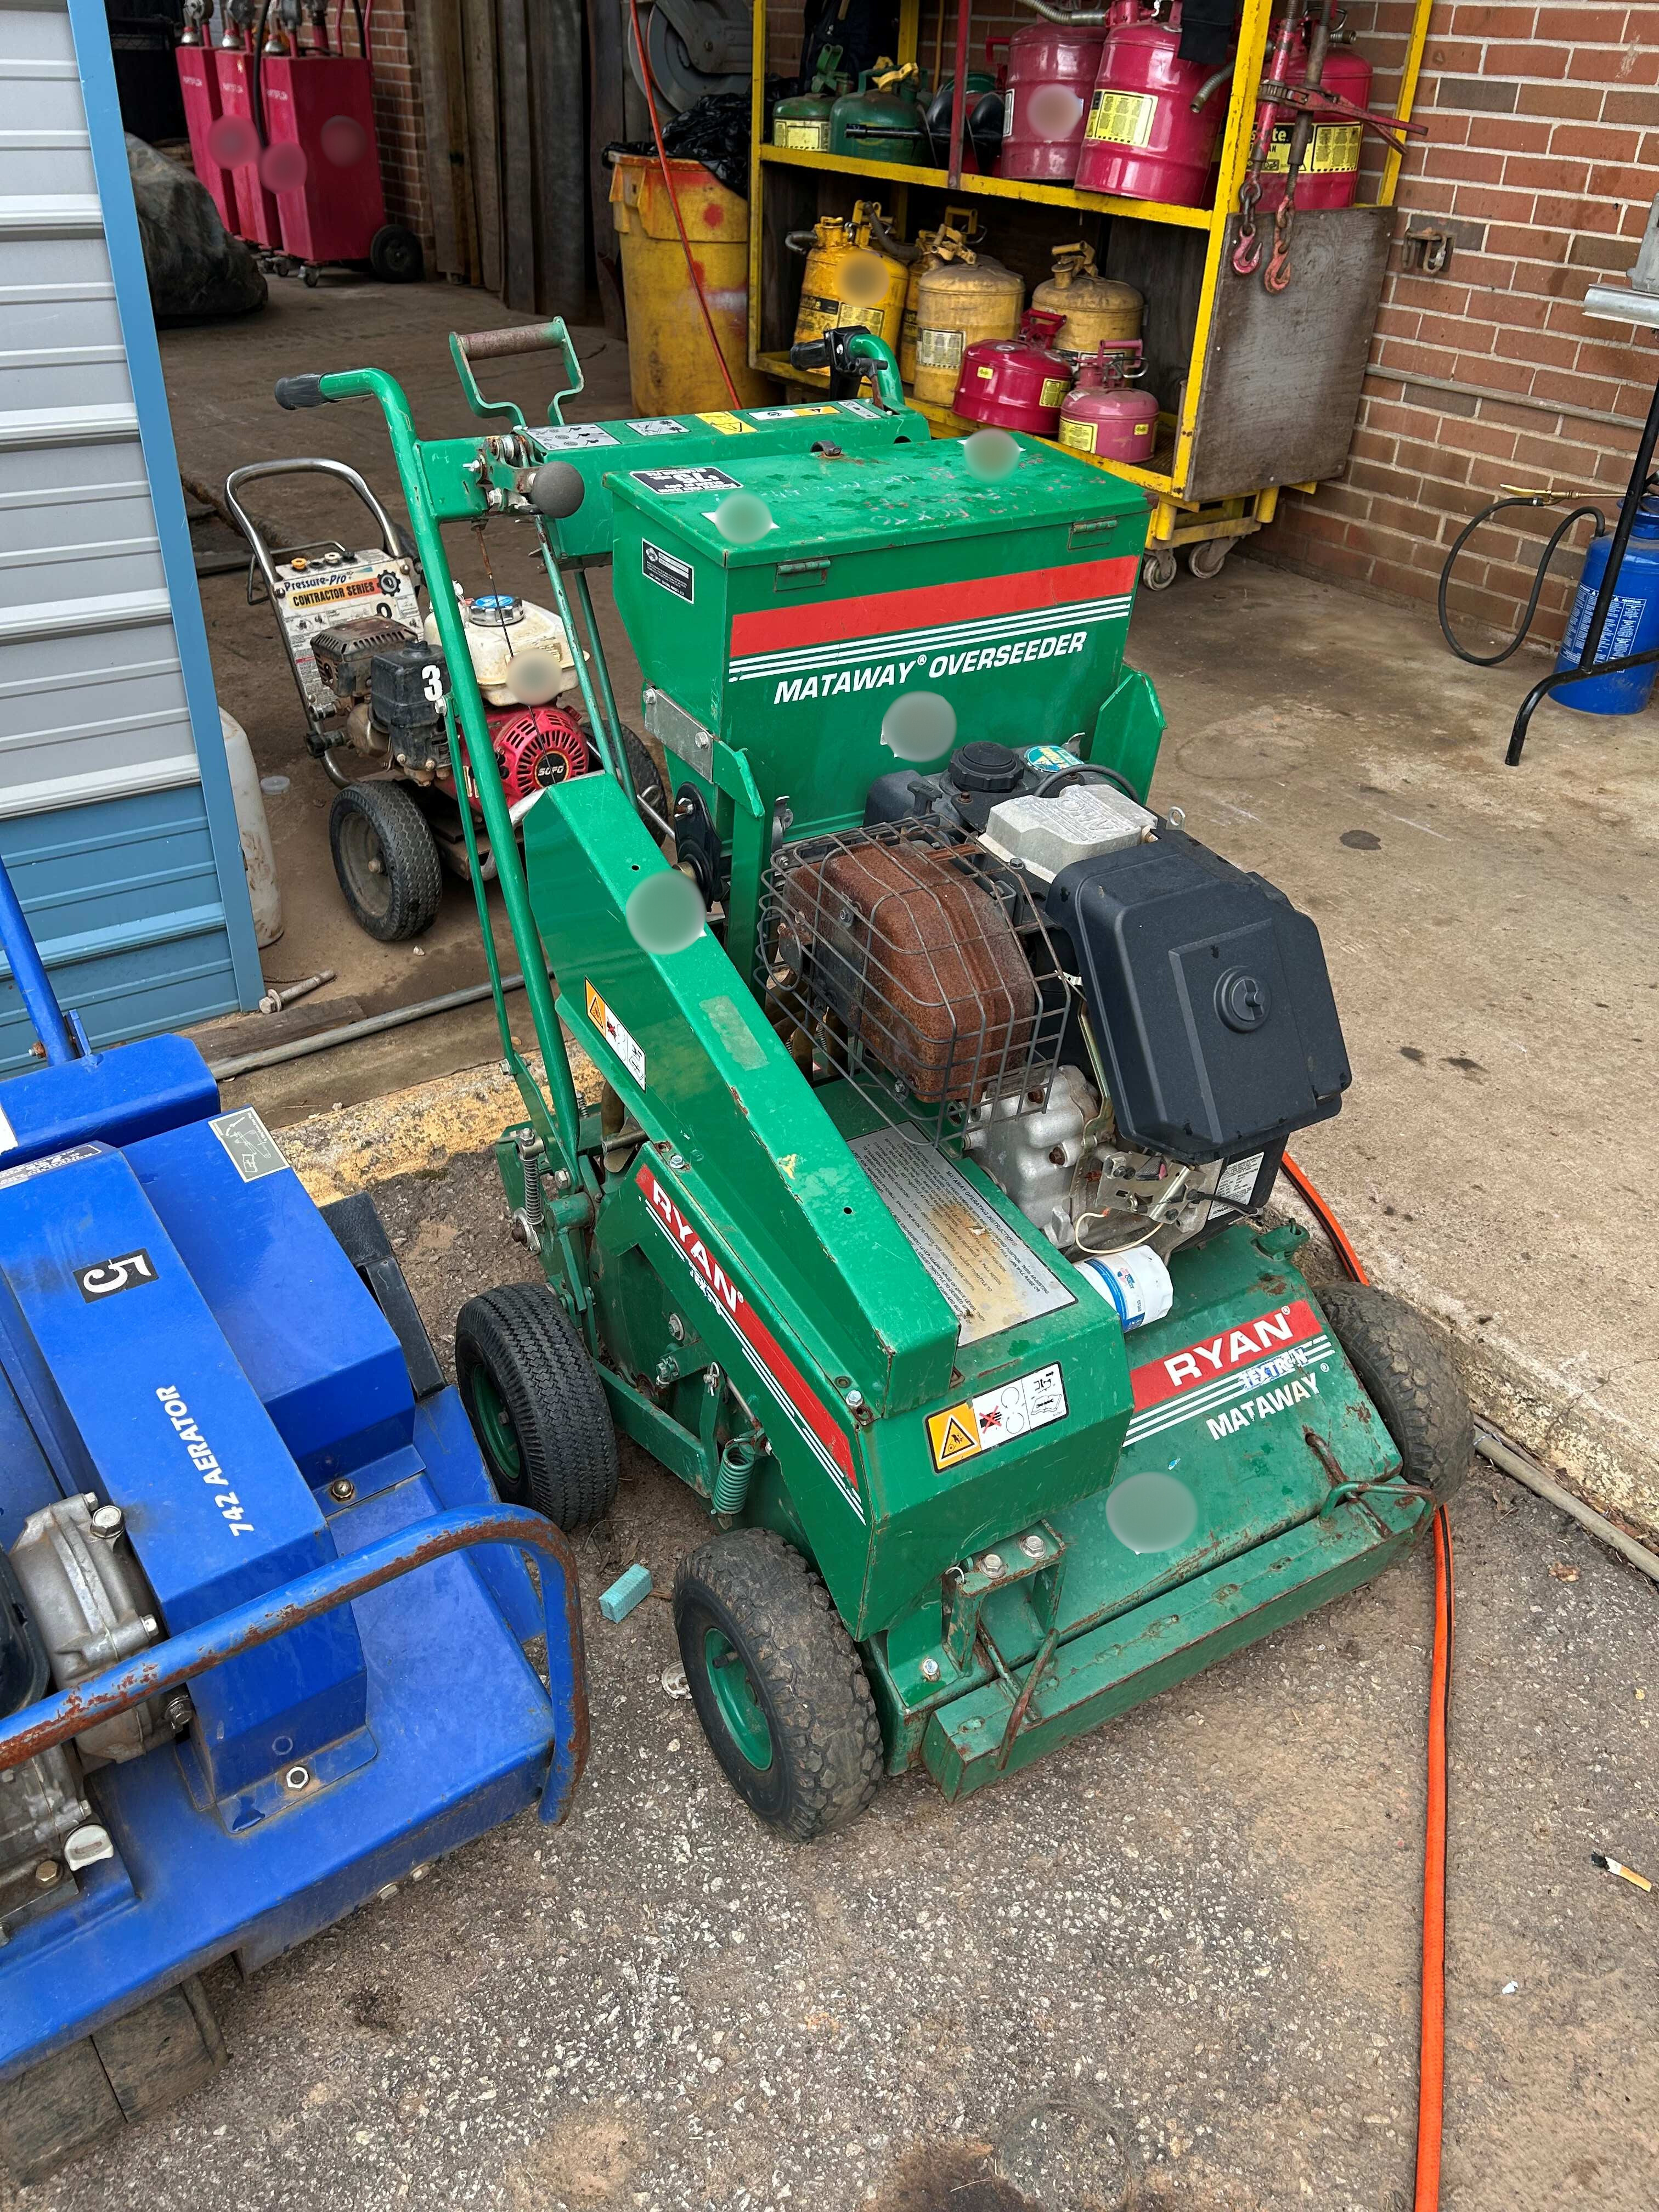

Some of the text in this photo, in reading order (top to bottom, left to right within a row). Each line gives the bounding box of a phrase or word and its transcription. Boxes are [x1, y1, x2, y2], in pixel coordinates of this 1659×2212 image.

[284, 574, 347, 591] Pressure-Pro
[293, 582, 375, 606] CONTRACTOR SERIES
[929, 632, 1087, 678] OVERSEEDER
[421, 665, 443, 702] 3
[945, 1171, 967, 1191] MATAWAY
[964, 1191, 989, 1215] OPERATING
[895, 1200, 909, 1214] SHOULD
[910, 1218, 921, 1228] MADE
[923, 1232, 935, 1244] CHECK
[952, 1266, 965, 1278] BLADE
[928, 1221, 941, 1232] LEVER
[969, 1268, 989, 1286] THROTTLE
[950, 1187, 960, 1195] HARD
[958, 1195, 973, 1210] SURFACE
[971, 1210, 981, 1218] WITH
[1029, 1274, 1050, 1294] ADJUSTING
[951, 1195, 963, 1206] TOUCH
[1023, 1275, 1036, 1286] RAISE
[83, 1255, 152, 1293] 5
[917, 1251, 930, 1265] ADJUST
[928, 1265, 946, 1283] THROTTLE
[918, 1245, 931, 1257] LEVER
[928, 1256, 944, 1272] AGAINST
[941, 1271, 953, 1282] KNOB
[954, 1286, 967, 1299] DRIVE
[974, 1311, 986, 1322] THEN
[156, 1385, 255, 1537] 742 AERATOR
